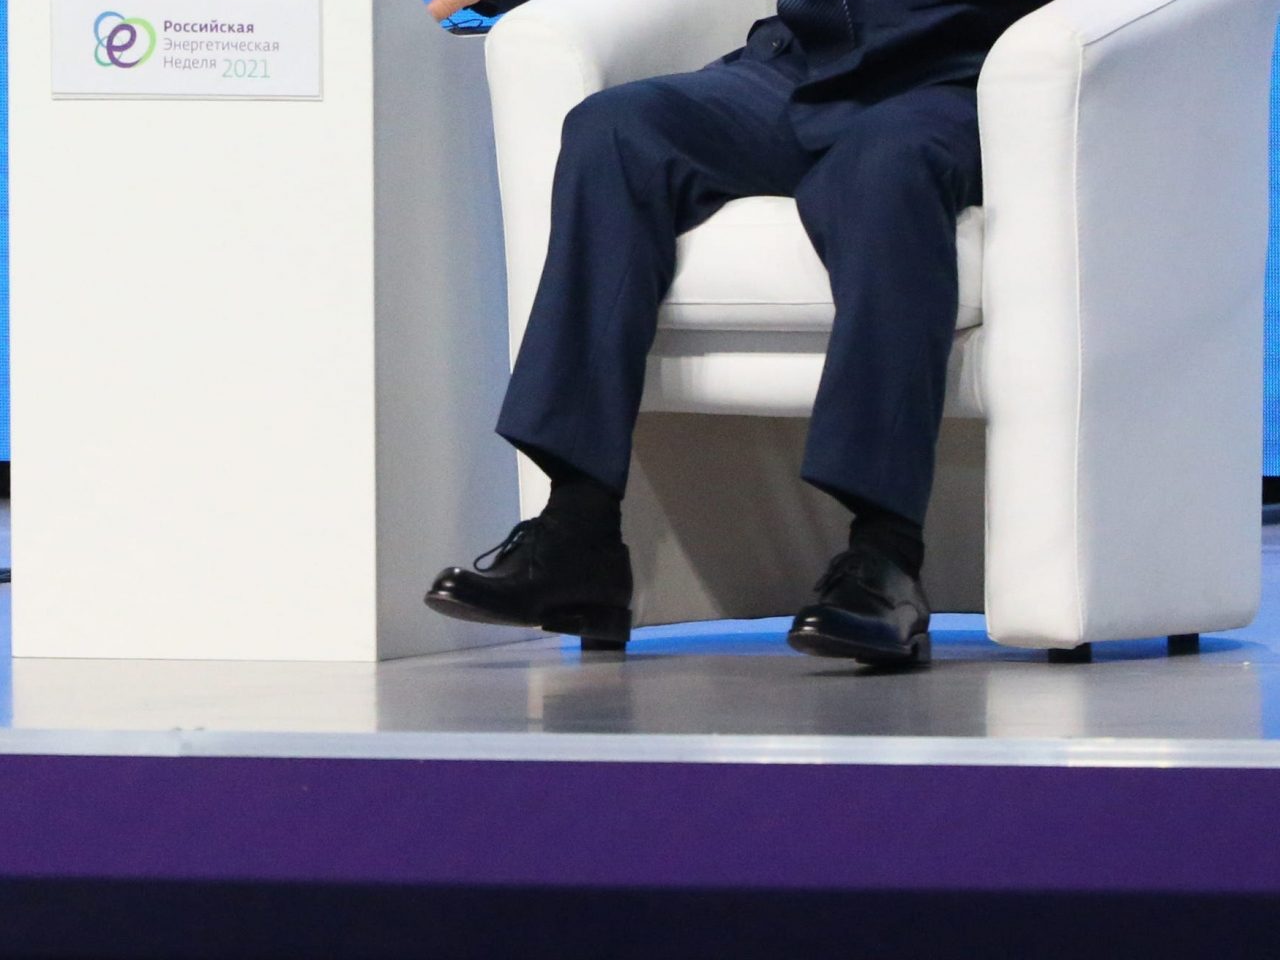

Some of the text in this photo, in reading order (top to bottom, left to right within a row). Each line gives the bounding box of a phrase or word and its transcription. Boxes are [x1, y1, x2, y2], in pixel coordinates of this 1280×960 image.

[163, 20, 254, 33] Российская
[163, 38, 280, 53] Энергетическая
[163, 56, 270, 78] Неделя 2021
